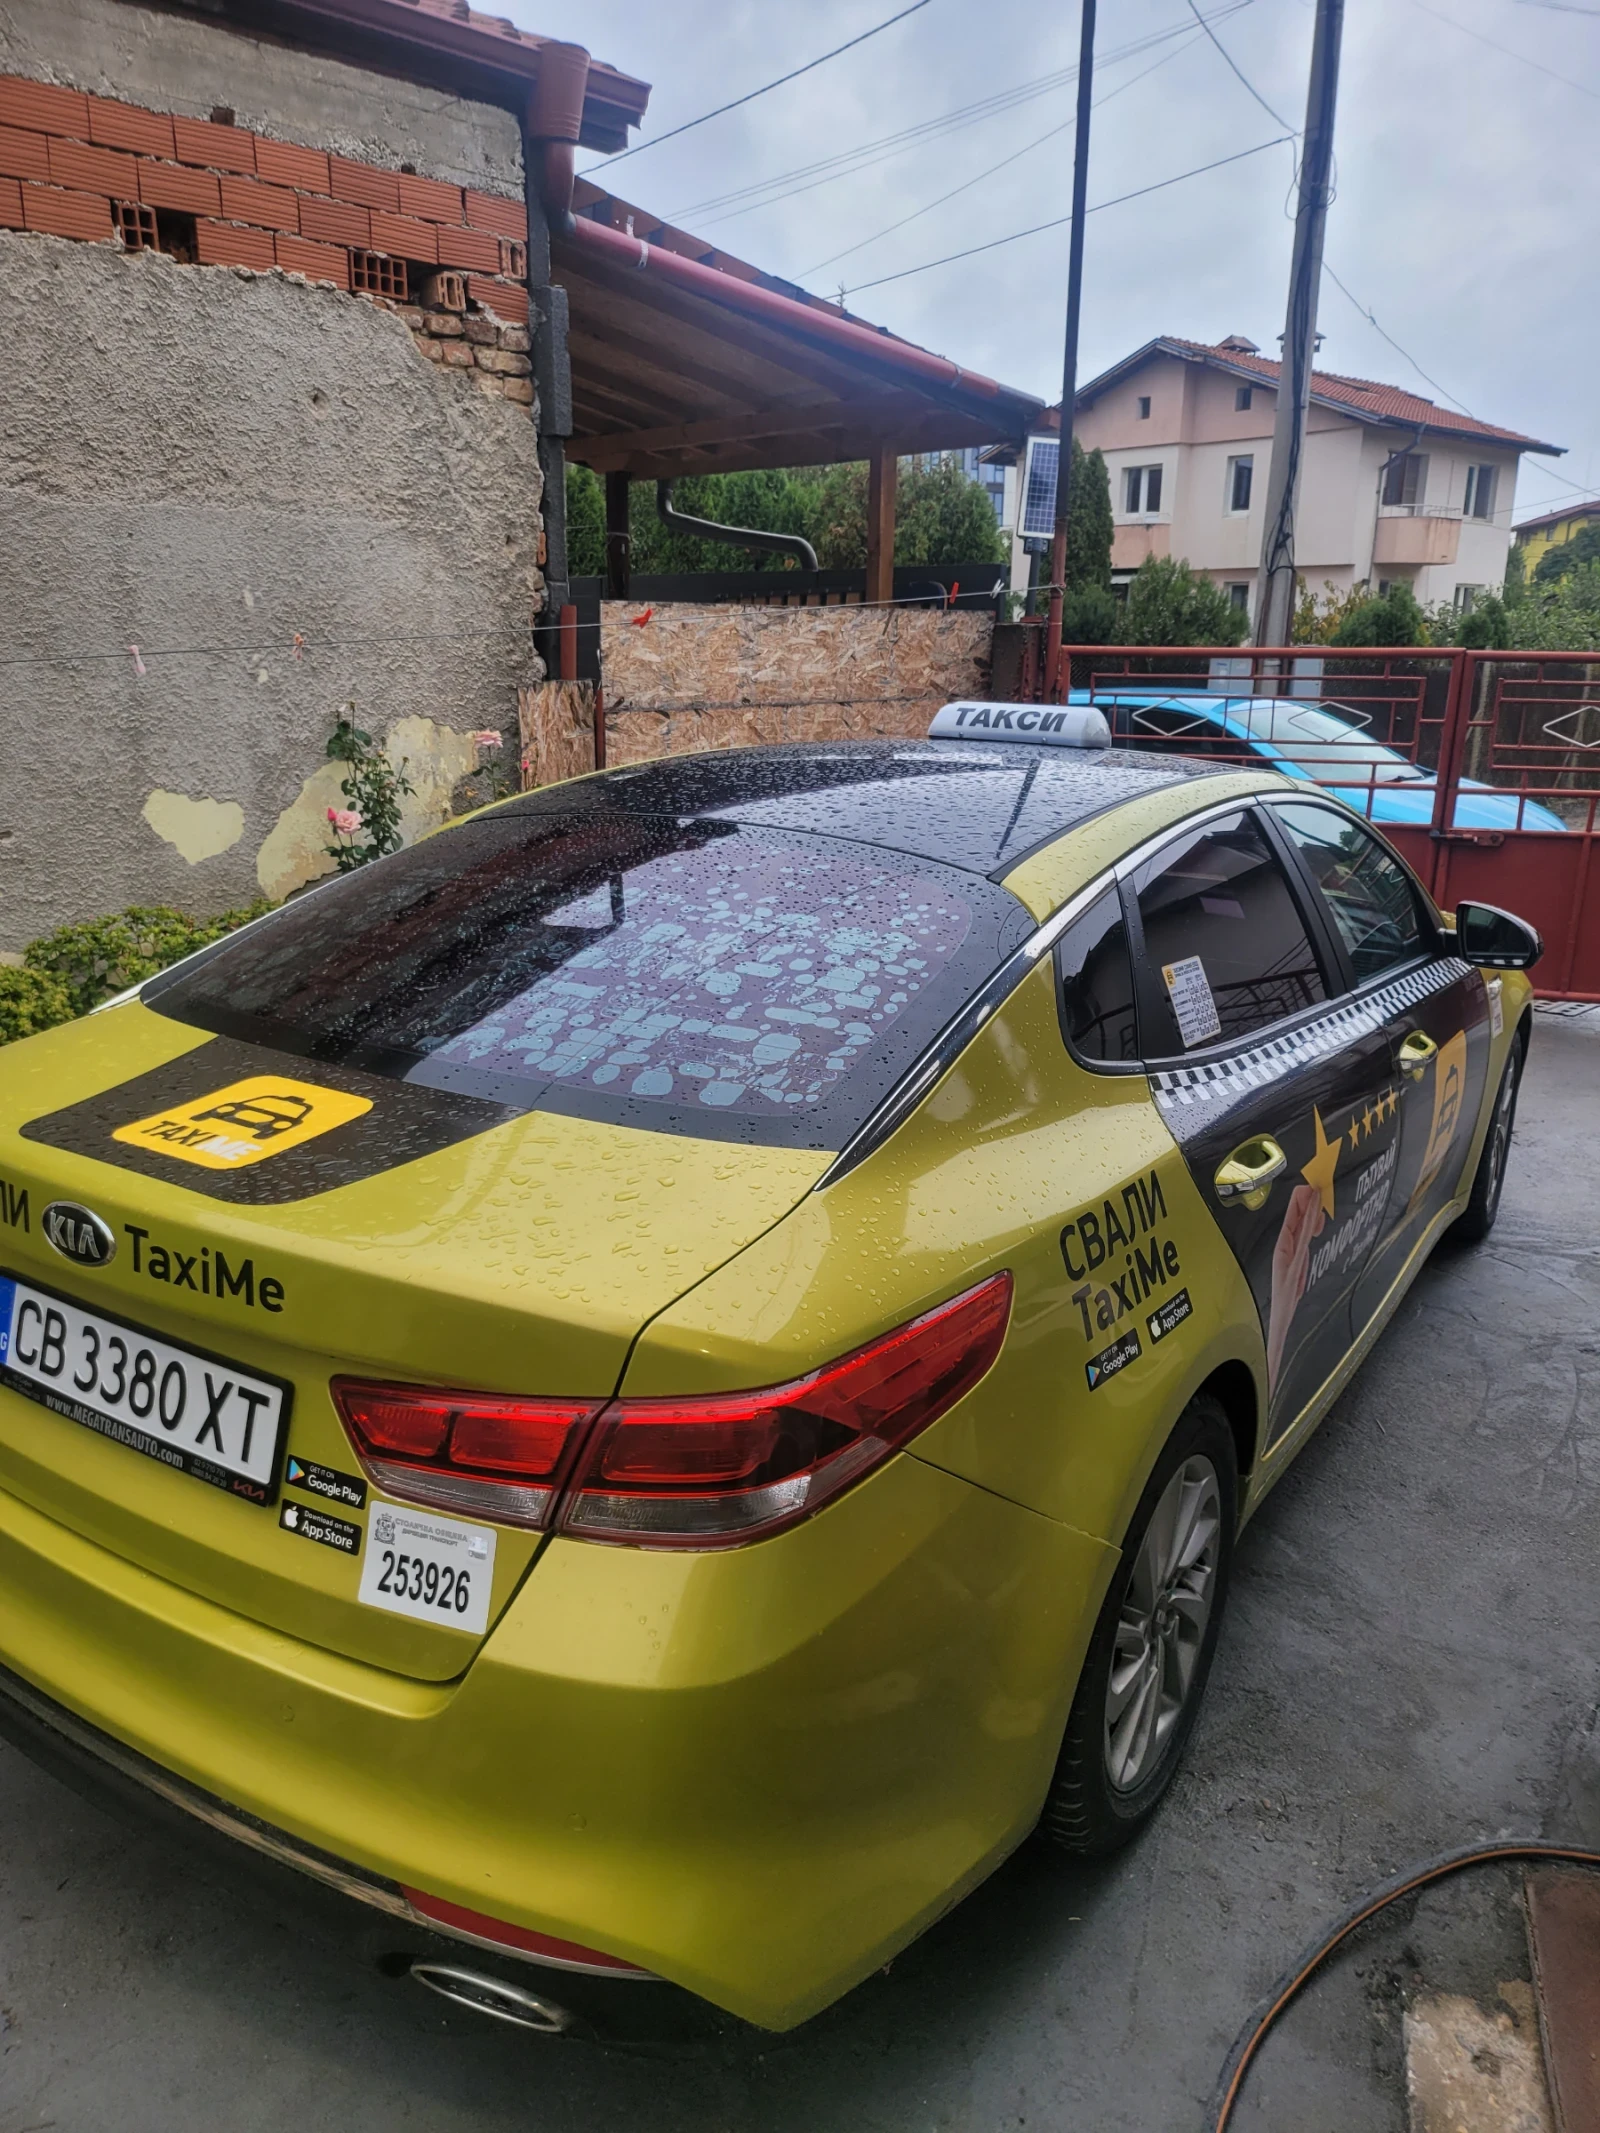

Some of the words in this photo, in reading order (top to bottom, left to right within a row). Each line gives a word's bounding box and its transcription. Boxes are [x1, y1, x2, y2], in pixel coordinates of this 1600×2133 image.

[955, 707, 1068, 732] ТАКСИ
[49, 1211, 101, 1258] KIA
[1059, 1169, 1168, 1281] СВАЛИ
[124, 1223, 285, 1313] TaxiMe
[1072, 1236, 1180, 1342] TaxiMe
[1162, 1315, 1176, 1330] App
[1173, 1303, 1189, 1320] Store
[1102, 1352, 1126, 1374] Google
[1124, 1343, 1139, 1358] Play
[46, 1395, 184, 1469] www.MEGATRANSAUTO.com
[309, 1465, 321, 1474] GET
[308, 1474, 341, 1497] Google
[342, 1486, 362, 1505] Play
[301, 1520, 323, 1540] App
[324, 1528, 353, 1549] Store
[304, 1510, 334, 1527] Download
[334, 1522, 342, 1530] on
[344, 1525, 354, 1534] the
[377, 1550, 471, 1613] 253926
